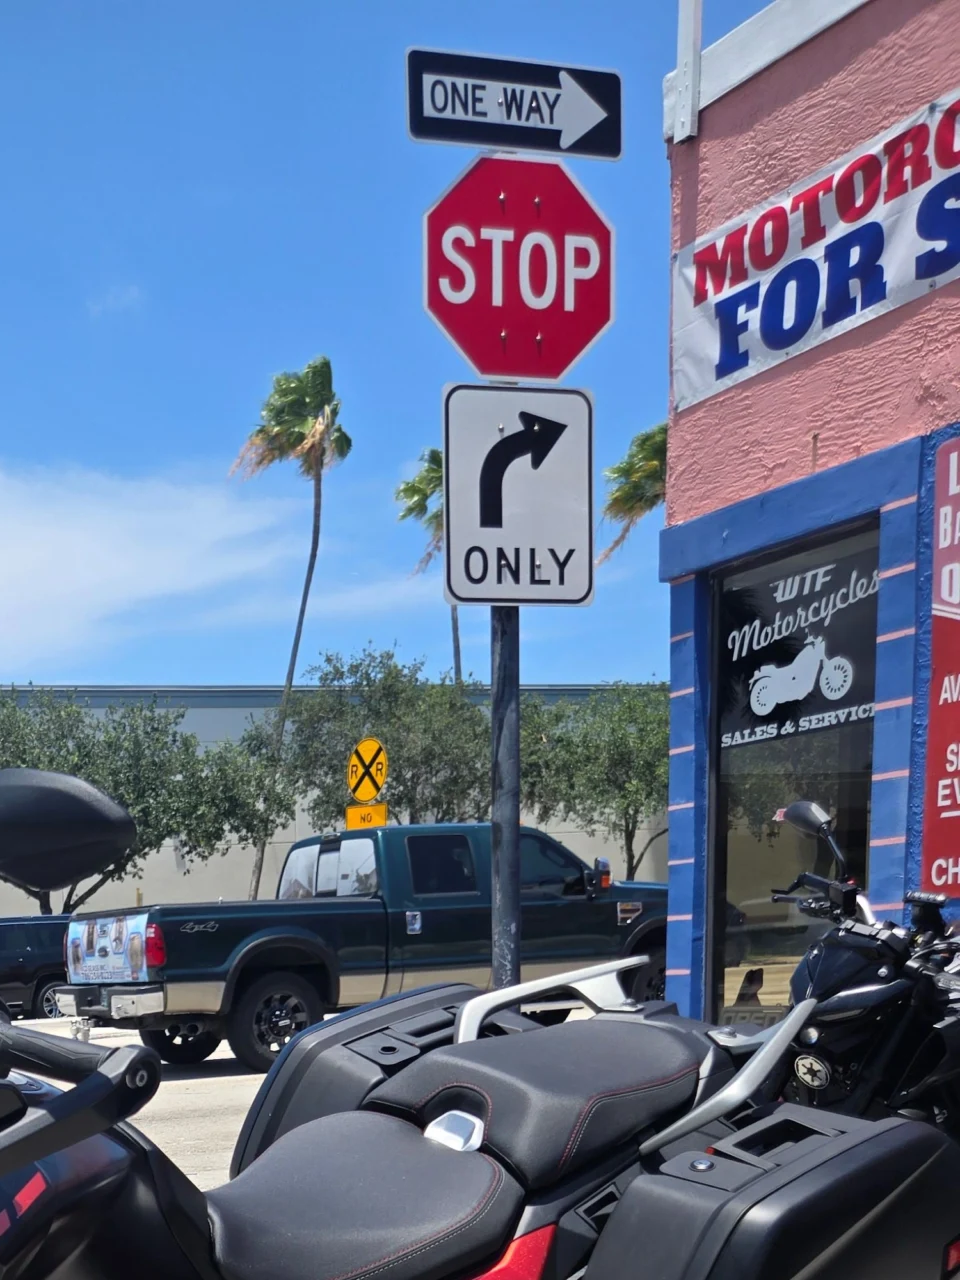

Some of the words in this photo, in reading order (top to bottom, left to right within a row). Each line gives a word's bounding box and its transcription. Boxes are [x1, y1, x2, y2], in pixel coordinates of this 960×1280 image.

[430, 79, 488, 117] ONE
[503, 87, 561, 125] WAY
[438, 225, 601, 312] STOP
[713, 221, 887, 381] FOR
[464, 546, 576, 585] ONLY
[769, 564, 836, 603] WTF
[727, 569, 880, 662] Motorcycles
[939, 673, 960, 705] AV
[721, 723, 778, 747] SALES
[780, 721, 796, 735] &
[946, 743, 960, 772] S
[360, 813, 372, 824] NO
